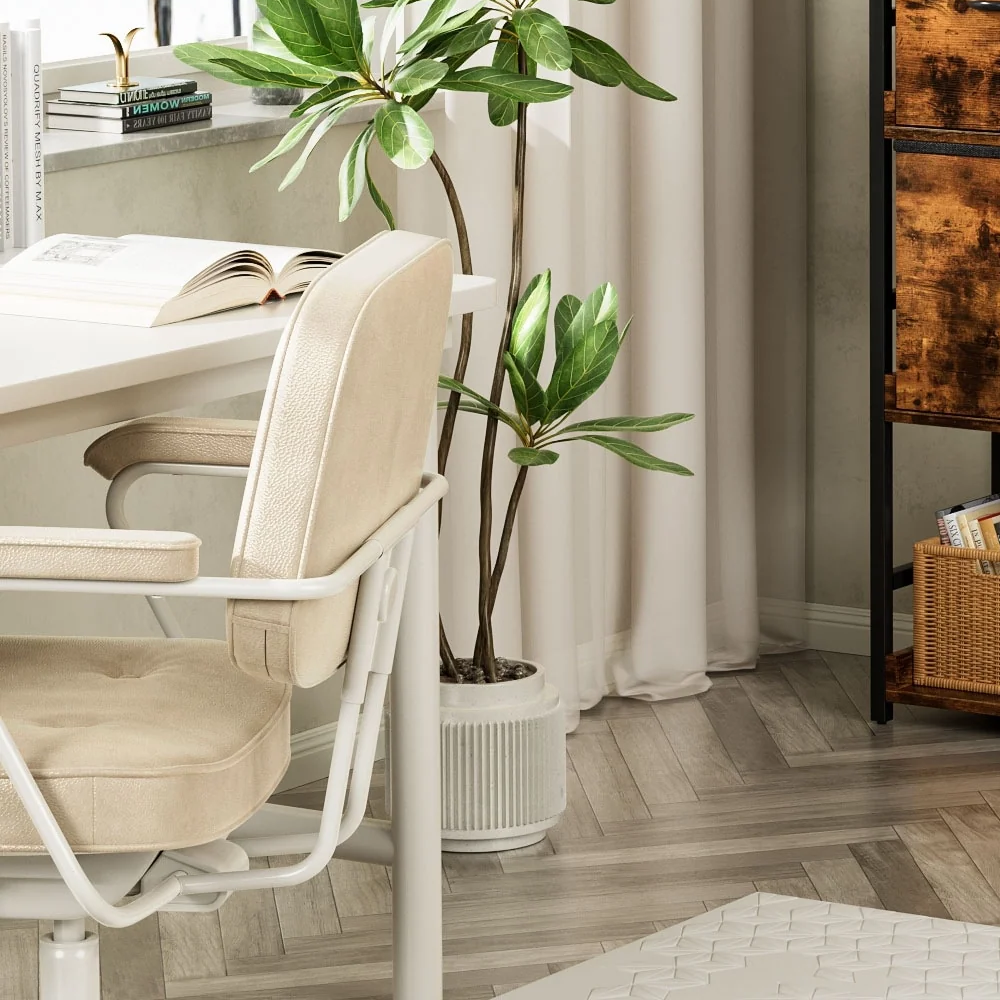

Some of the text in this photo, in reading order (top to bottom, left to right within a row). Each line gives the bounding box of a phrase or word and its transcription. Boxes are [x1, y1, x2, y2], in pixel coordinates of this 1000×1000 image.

[33, 64, 41, 128] QUADRIFY
[4, 161, 9, 171] OF
[35, 171, 42, 188] BY
